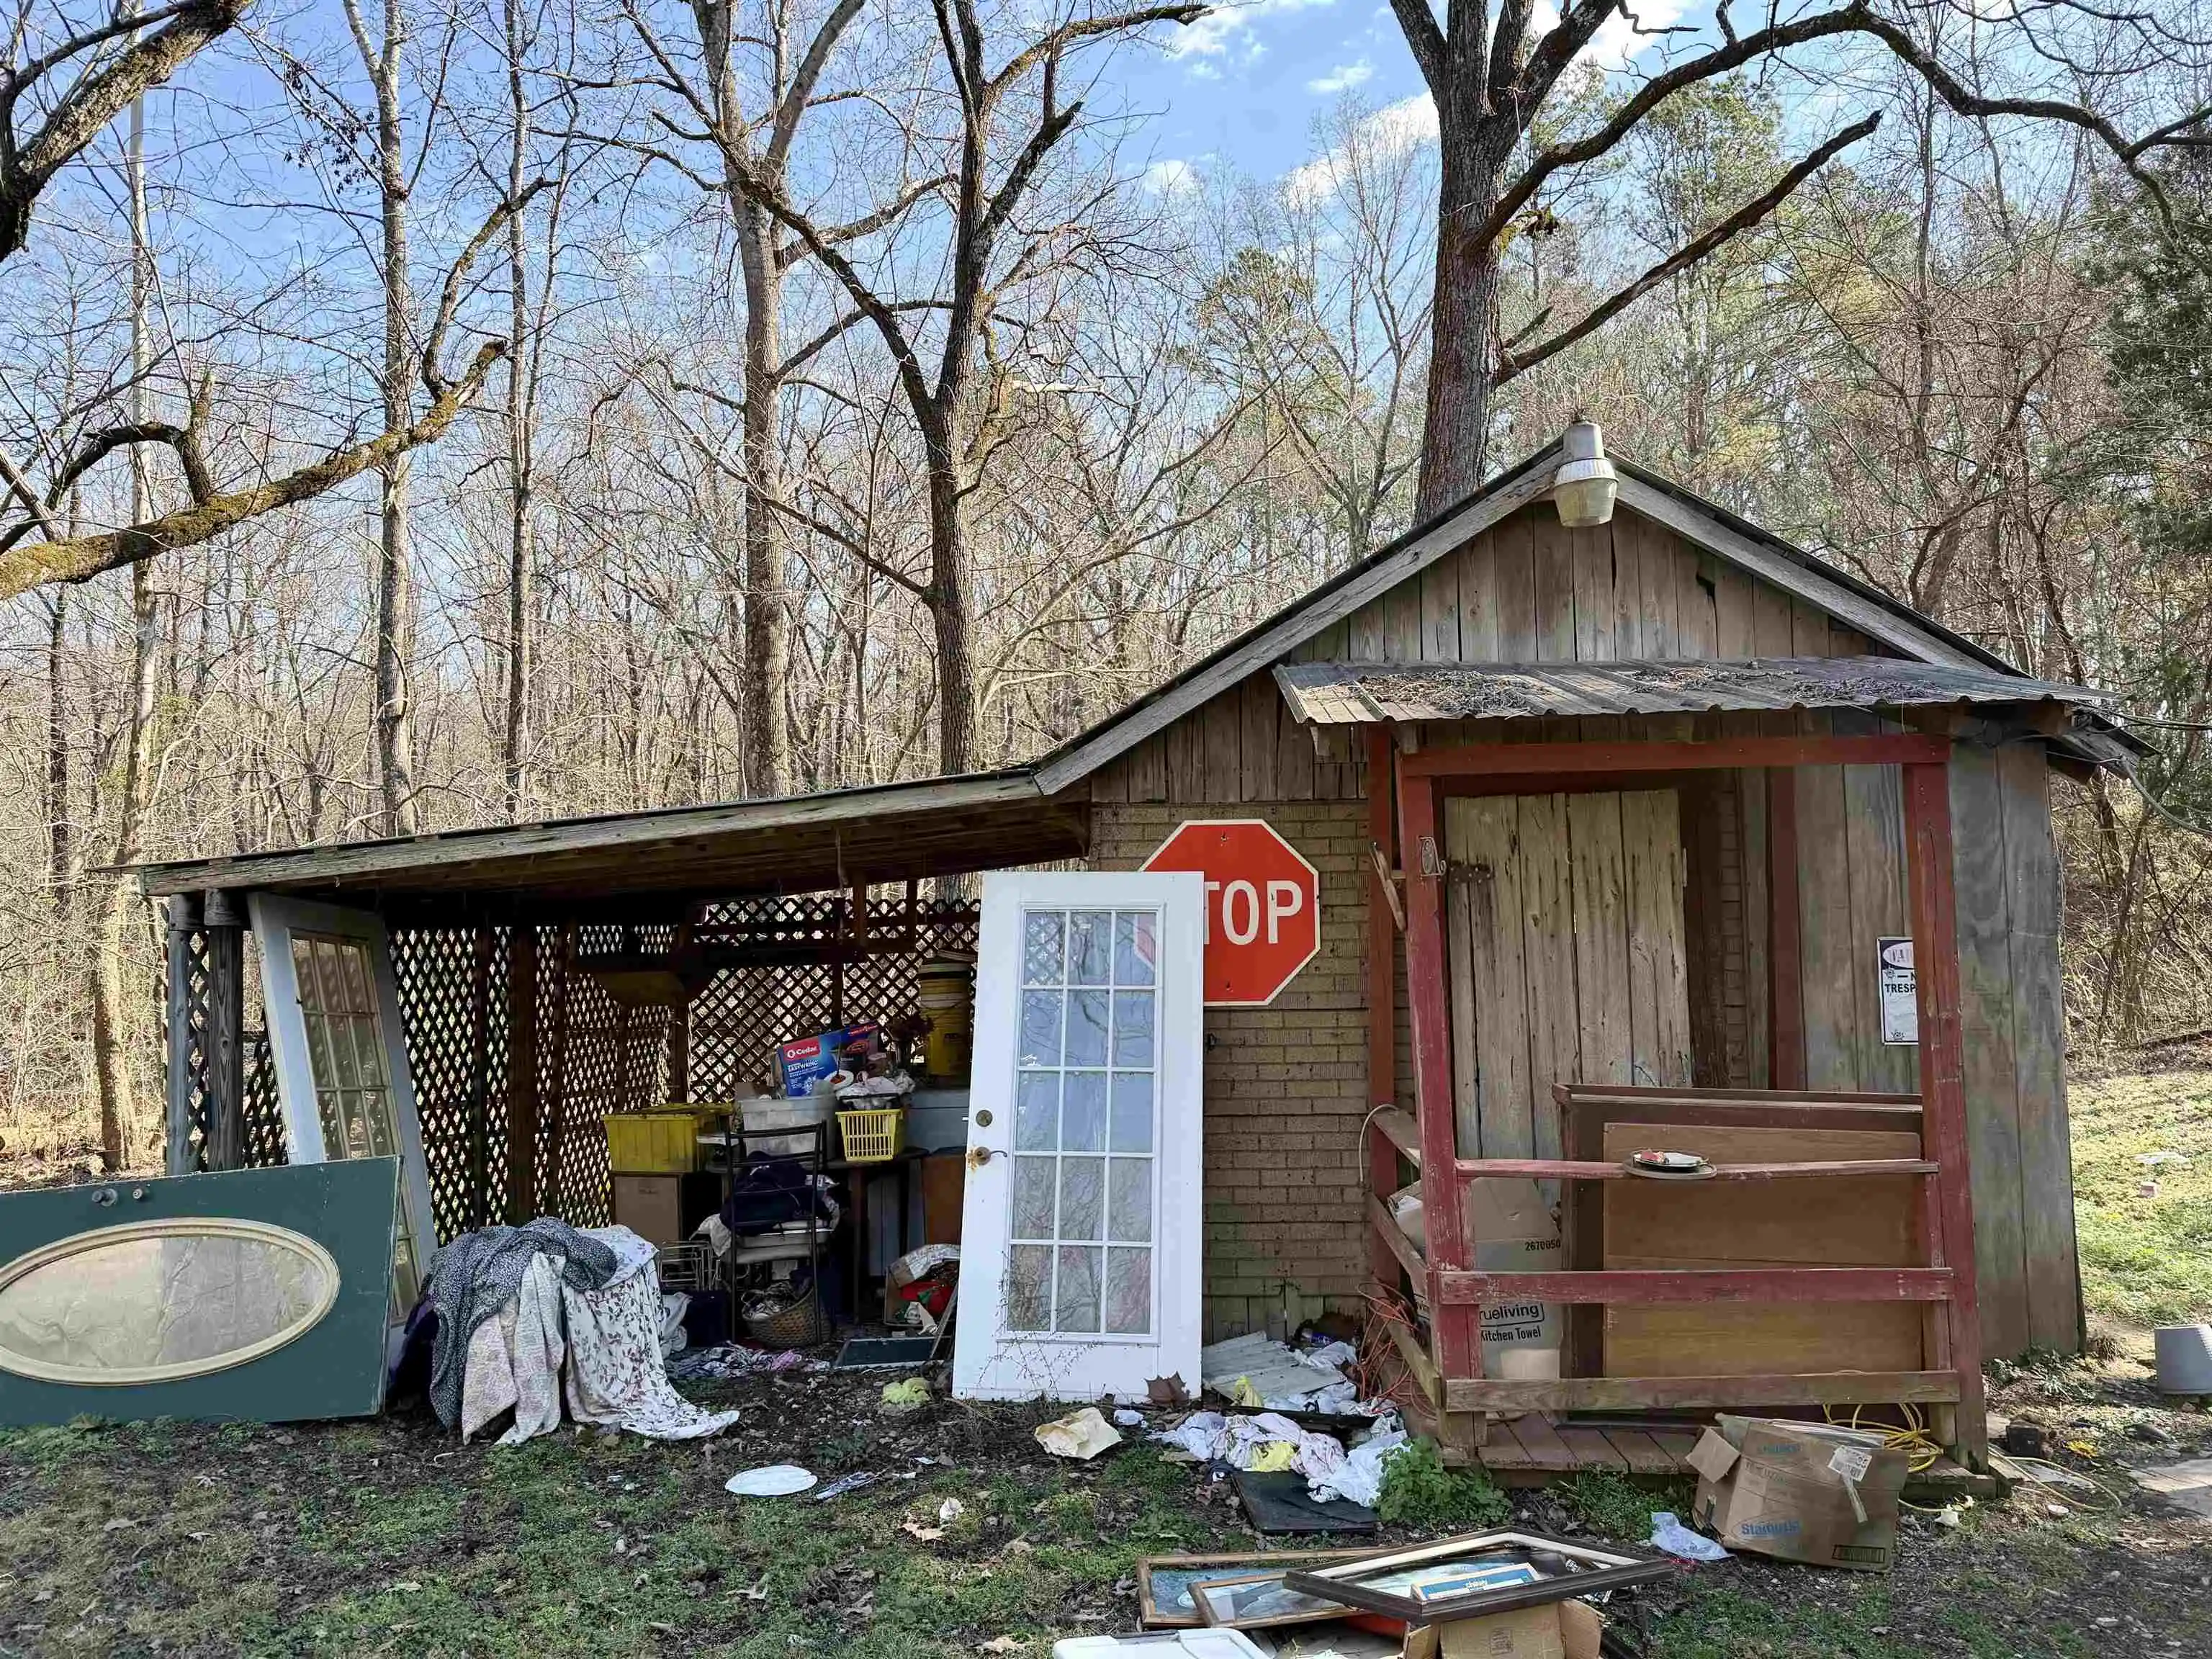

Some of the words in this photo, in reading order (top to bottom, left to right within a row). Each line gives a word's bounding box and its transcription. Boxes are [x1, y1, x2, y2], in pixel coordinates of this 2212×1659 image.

[1204, 880, 1303, 945] TOP
[1884, 984, 1917, 993] TRESP
[1480, 1304, 1539, 1320] rueliving
[1515, 1326, 1541, 1339] Towel
